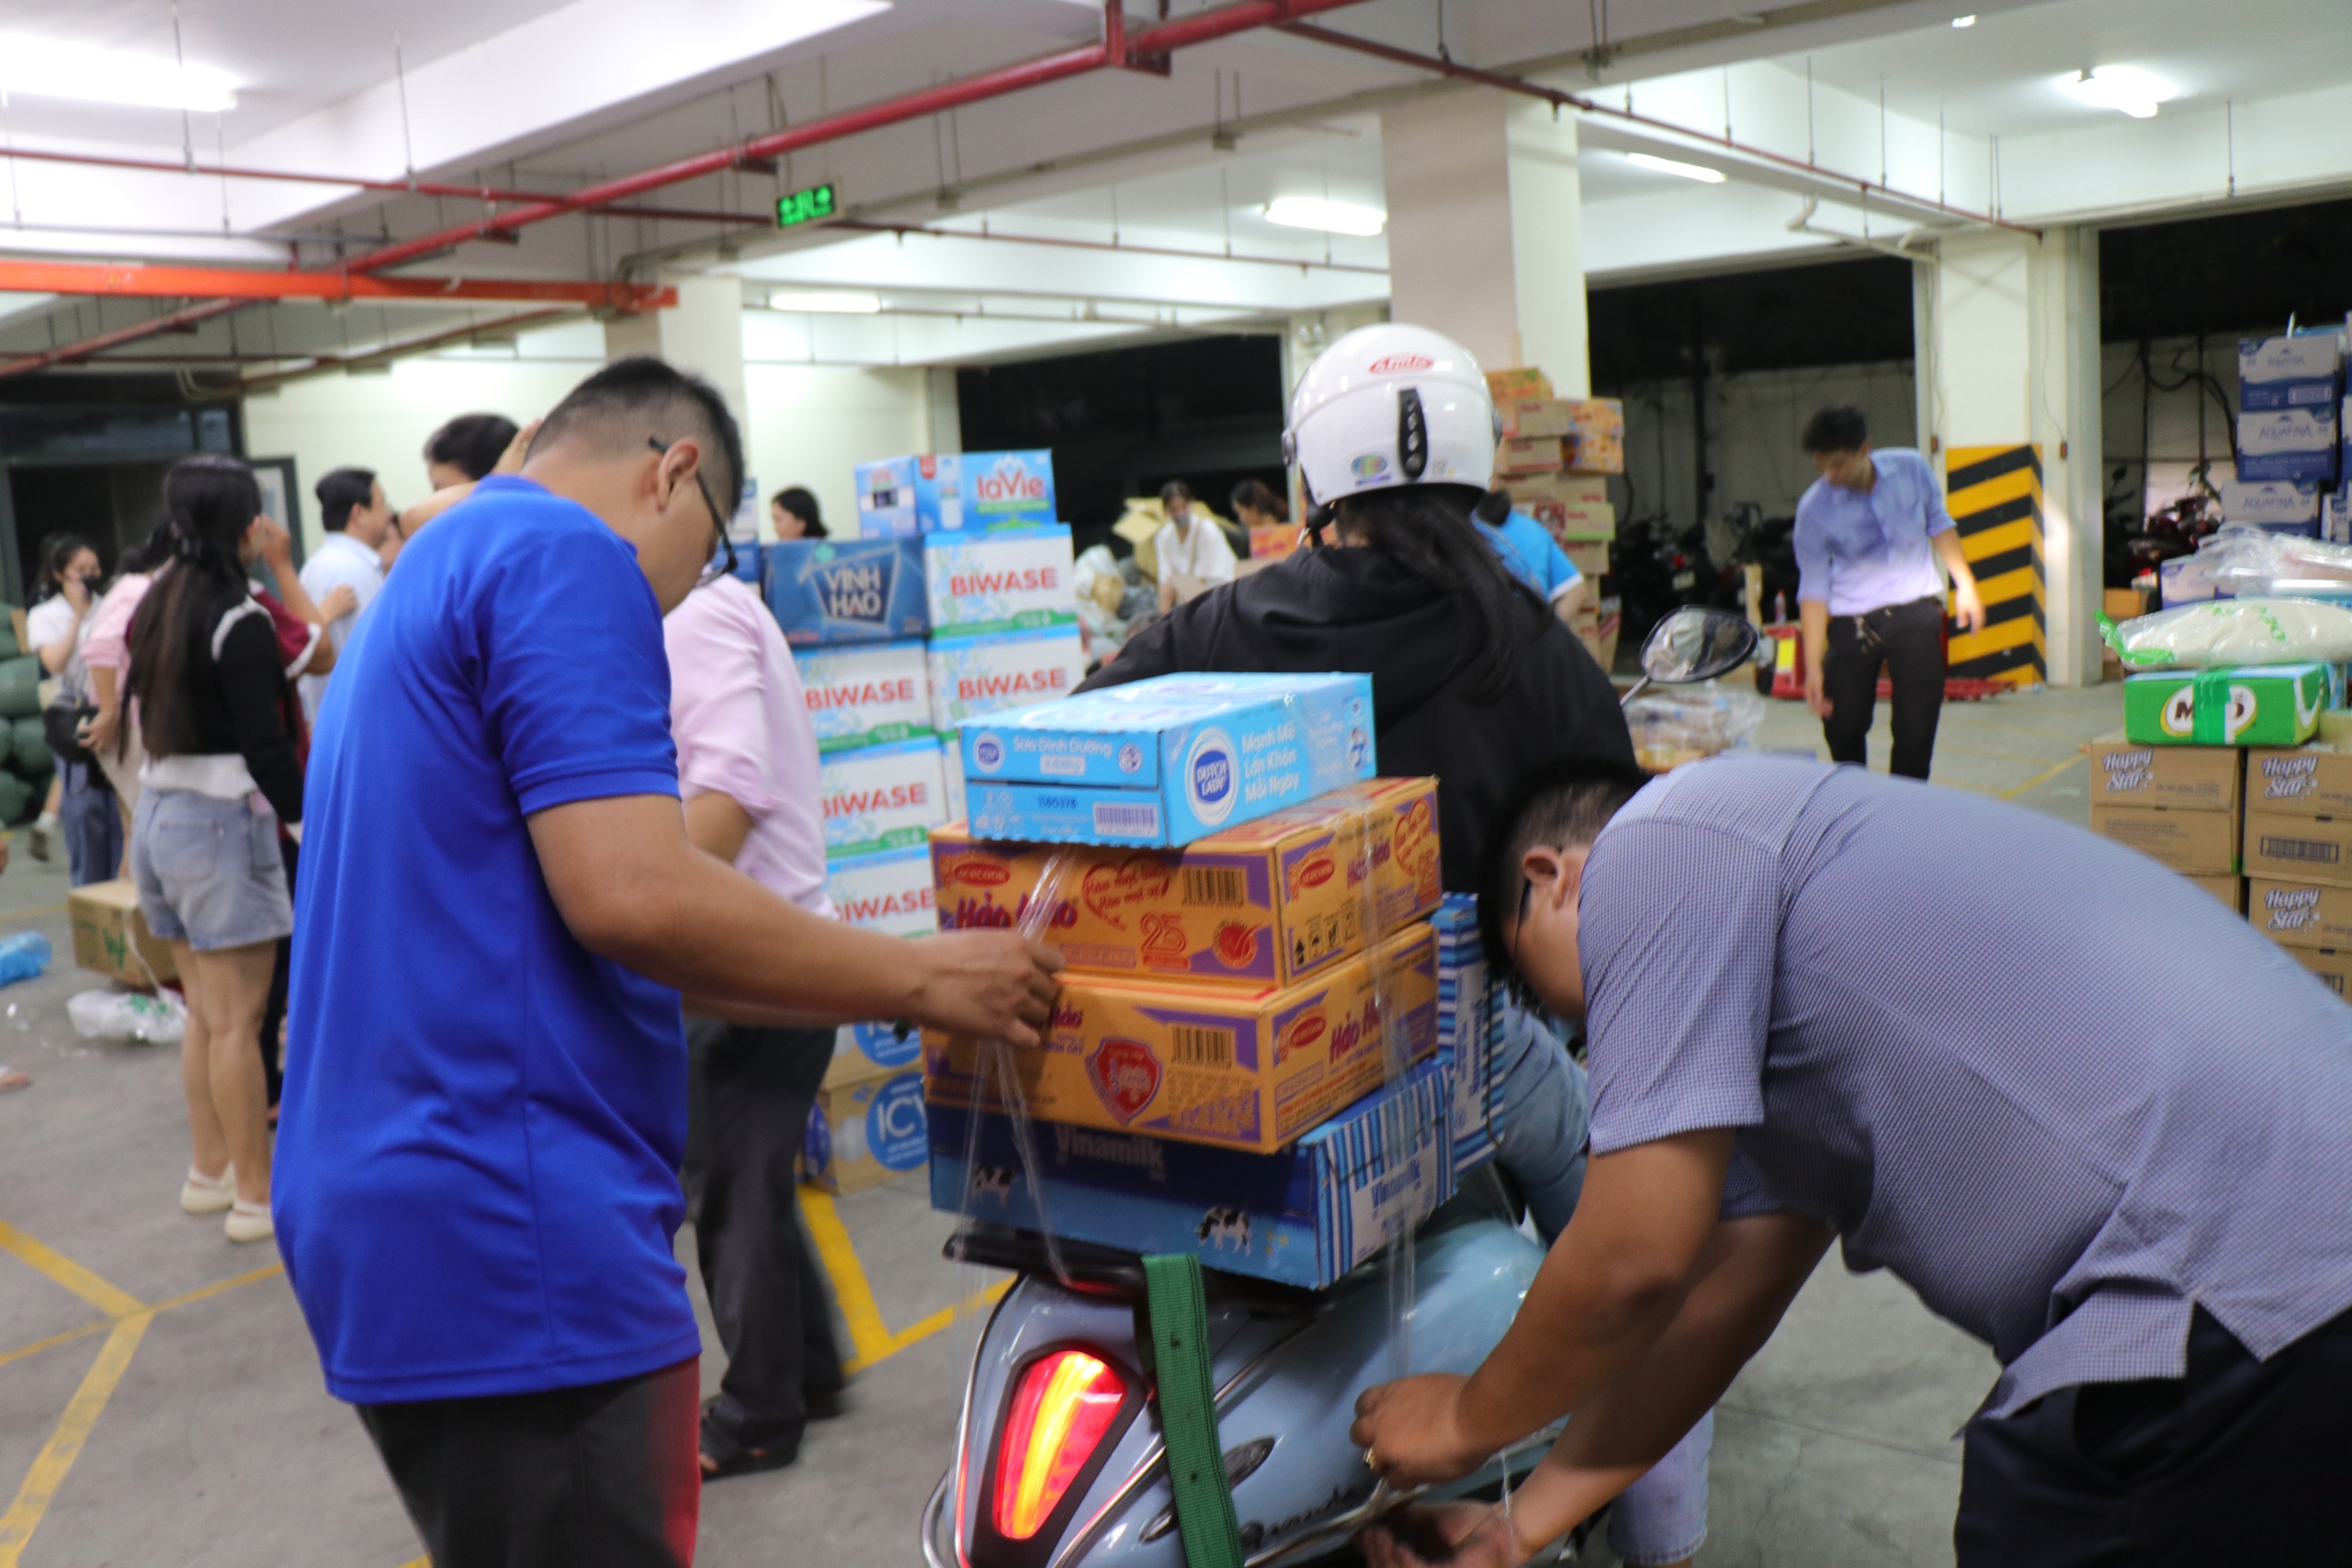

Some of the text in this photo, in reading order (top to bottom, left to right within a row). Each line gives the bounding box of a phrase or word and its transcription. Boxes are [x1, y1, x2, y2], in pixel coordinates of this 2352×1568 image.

[950, 567, 1057, 597] BIWASE
[806, 678, 914, 711] BIWASE
[957, 668, 1067, 700] BIWASE
[1038, 736, 1068, 752] Dinh
[1196, 759, 1227, 784] DUTCH
[2102, 749, 2154, 773] Happy
[2263, 755, 2319, 777] Happy
[1201, 775, 1227, 796] LADY
[2106, 771, 2145, 793] Star
[2265, 776, 2310, 799] Star
[2265, 888, 2321, 909] Happy
[2267, 908, 2310, 931] Star
[1054, 1122, 1164, 1171] Vinamilk
